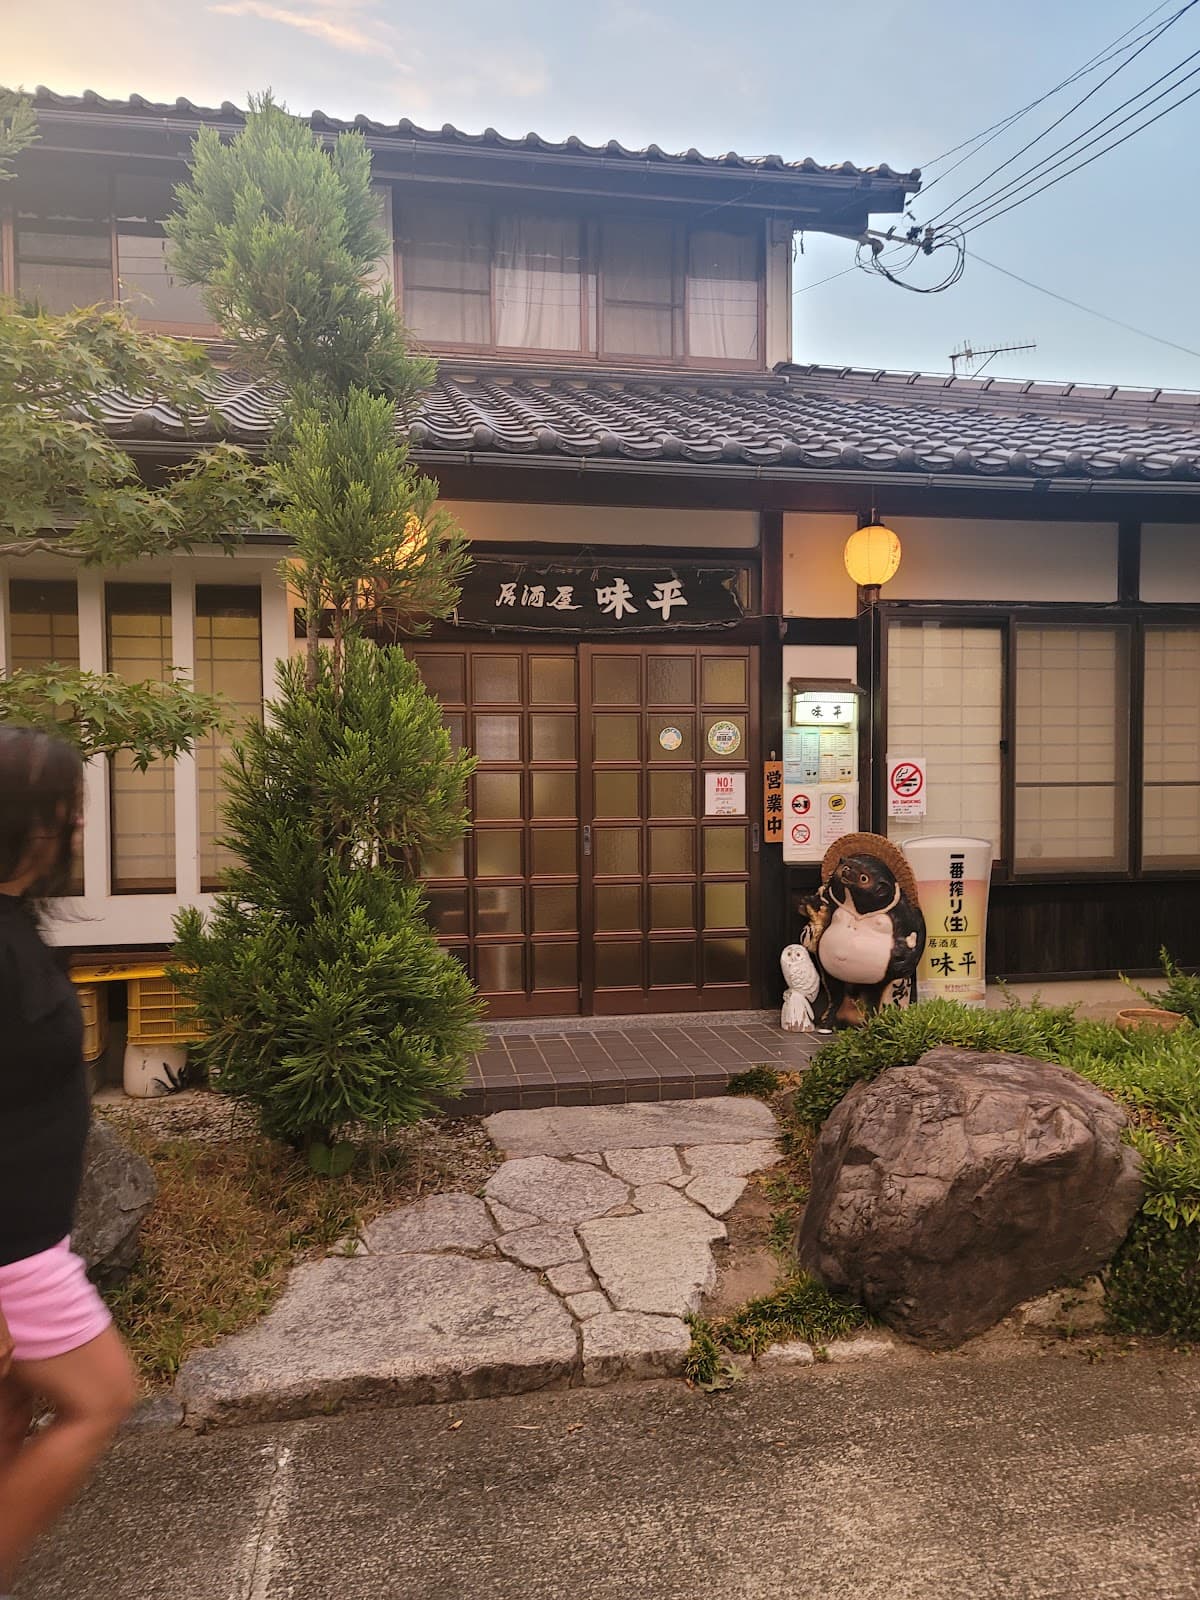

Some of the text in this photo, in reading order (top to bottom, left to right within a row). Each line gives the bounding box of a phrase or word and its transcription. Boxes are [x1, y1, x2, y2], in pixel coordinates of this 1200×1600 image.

[495, 577, 688, 621] 居酒屋 味平
[811, 705, 842, 719] 味平
[717, 777, 733, 787] NO!
[767, 770, 782, 835] 営業中
[928, 939, 958, 948] 居酒屋
[930, 952, 977, 976] 味平
